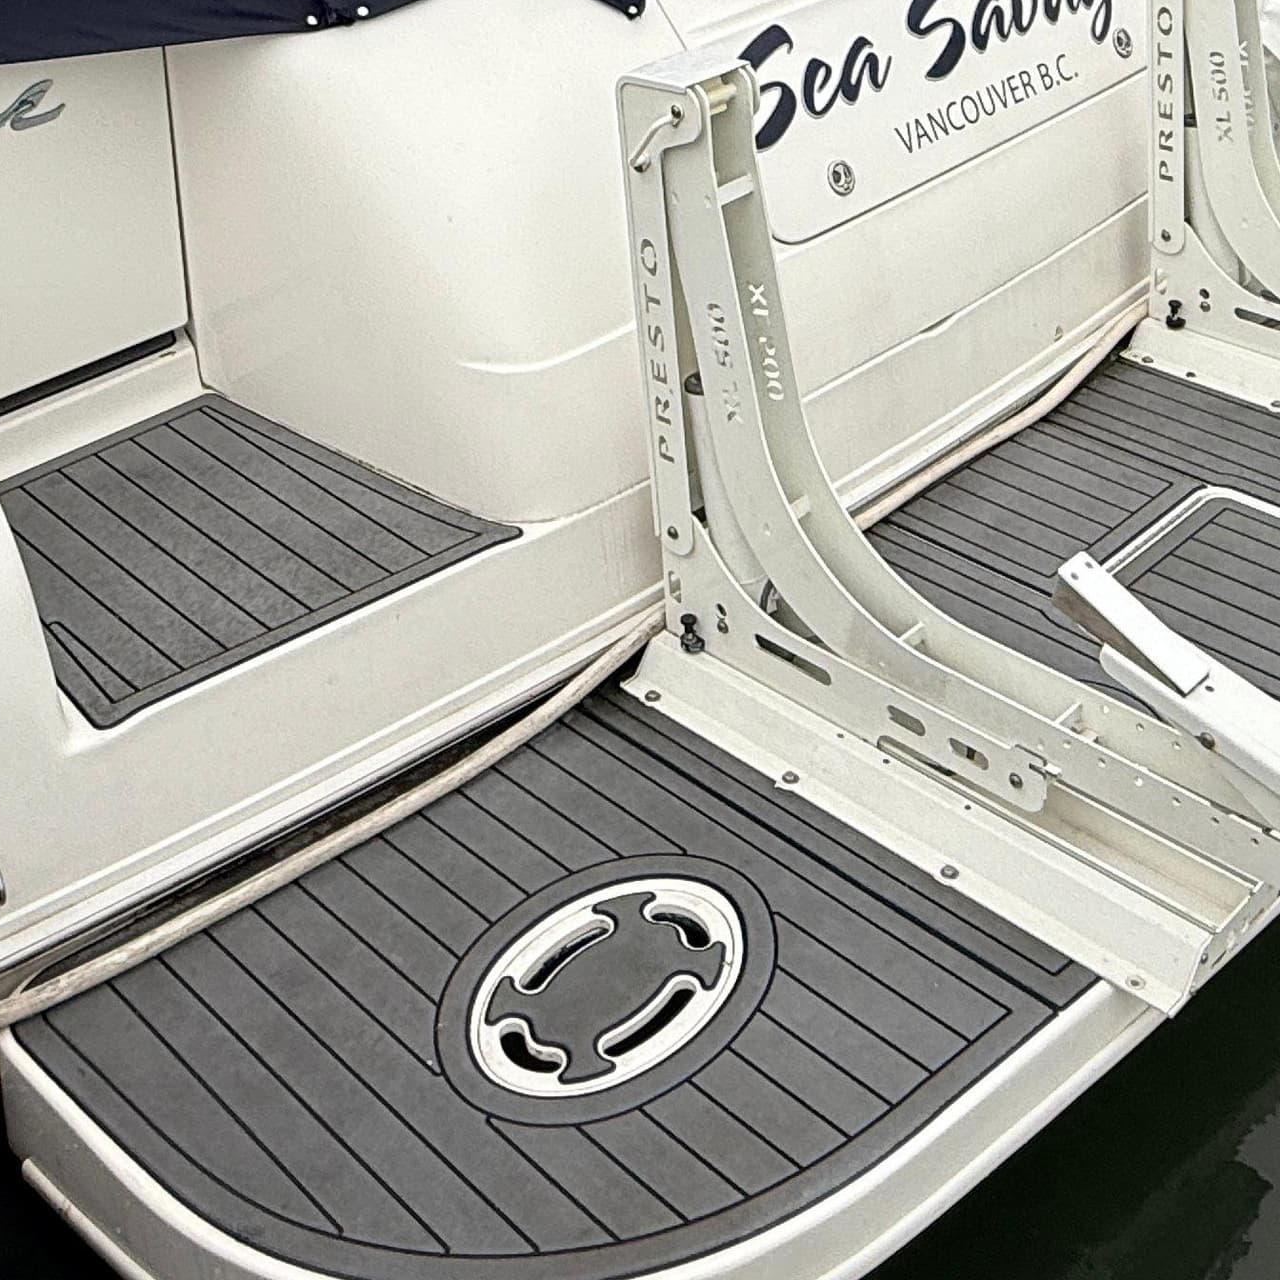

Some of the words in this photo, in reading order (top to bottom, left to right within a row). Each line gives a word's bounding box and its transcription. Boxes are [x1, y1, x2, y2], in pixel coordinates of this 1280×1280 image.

[737, 23, 892, 153] Sea
[894, 70, 1036, 154] VANCOUVER
[1037, 53, 1080, 93] B.C.
[1157, 6, 1174, 182] PRESTO
[1208, 51, 1230, 102] 500
[1215, 111, 1234, 143] XL
[640, 238, 676, 464] PRESTO
